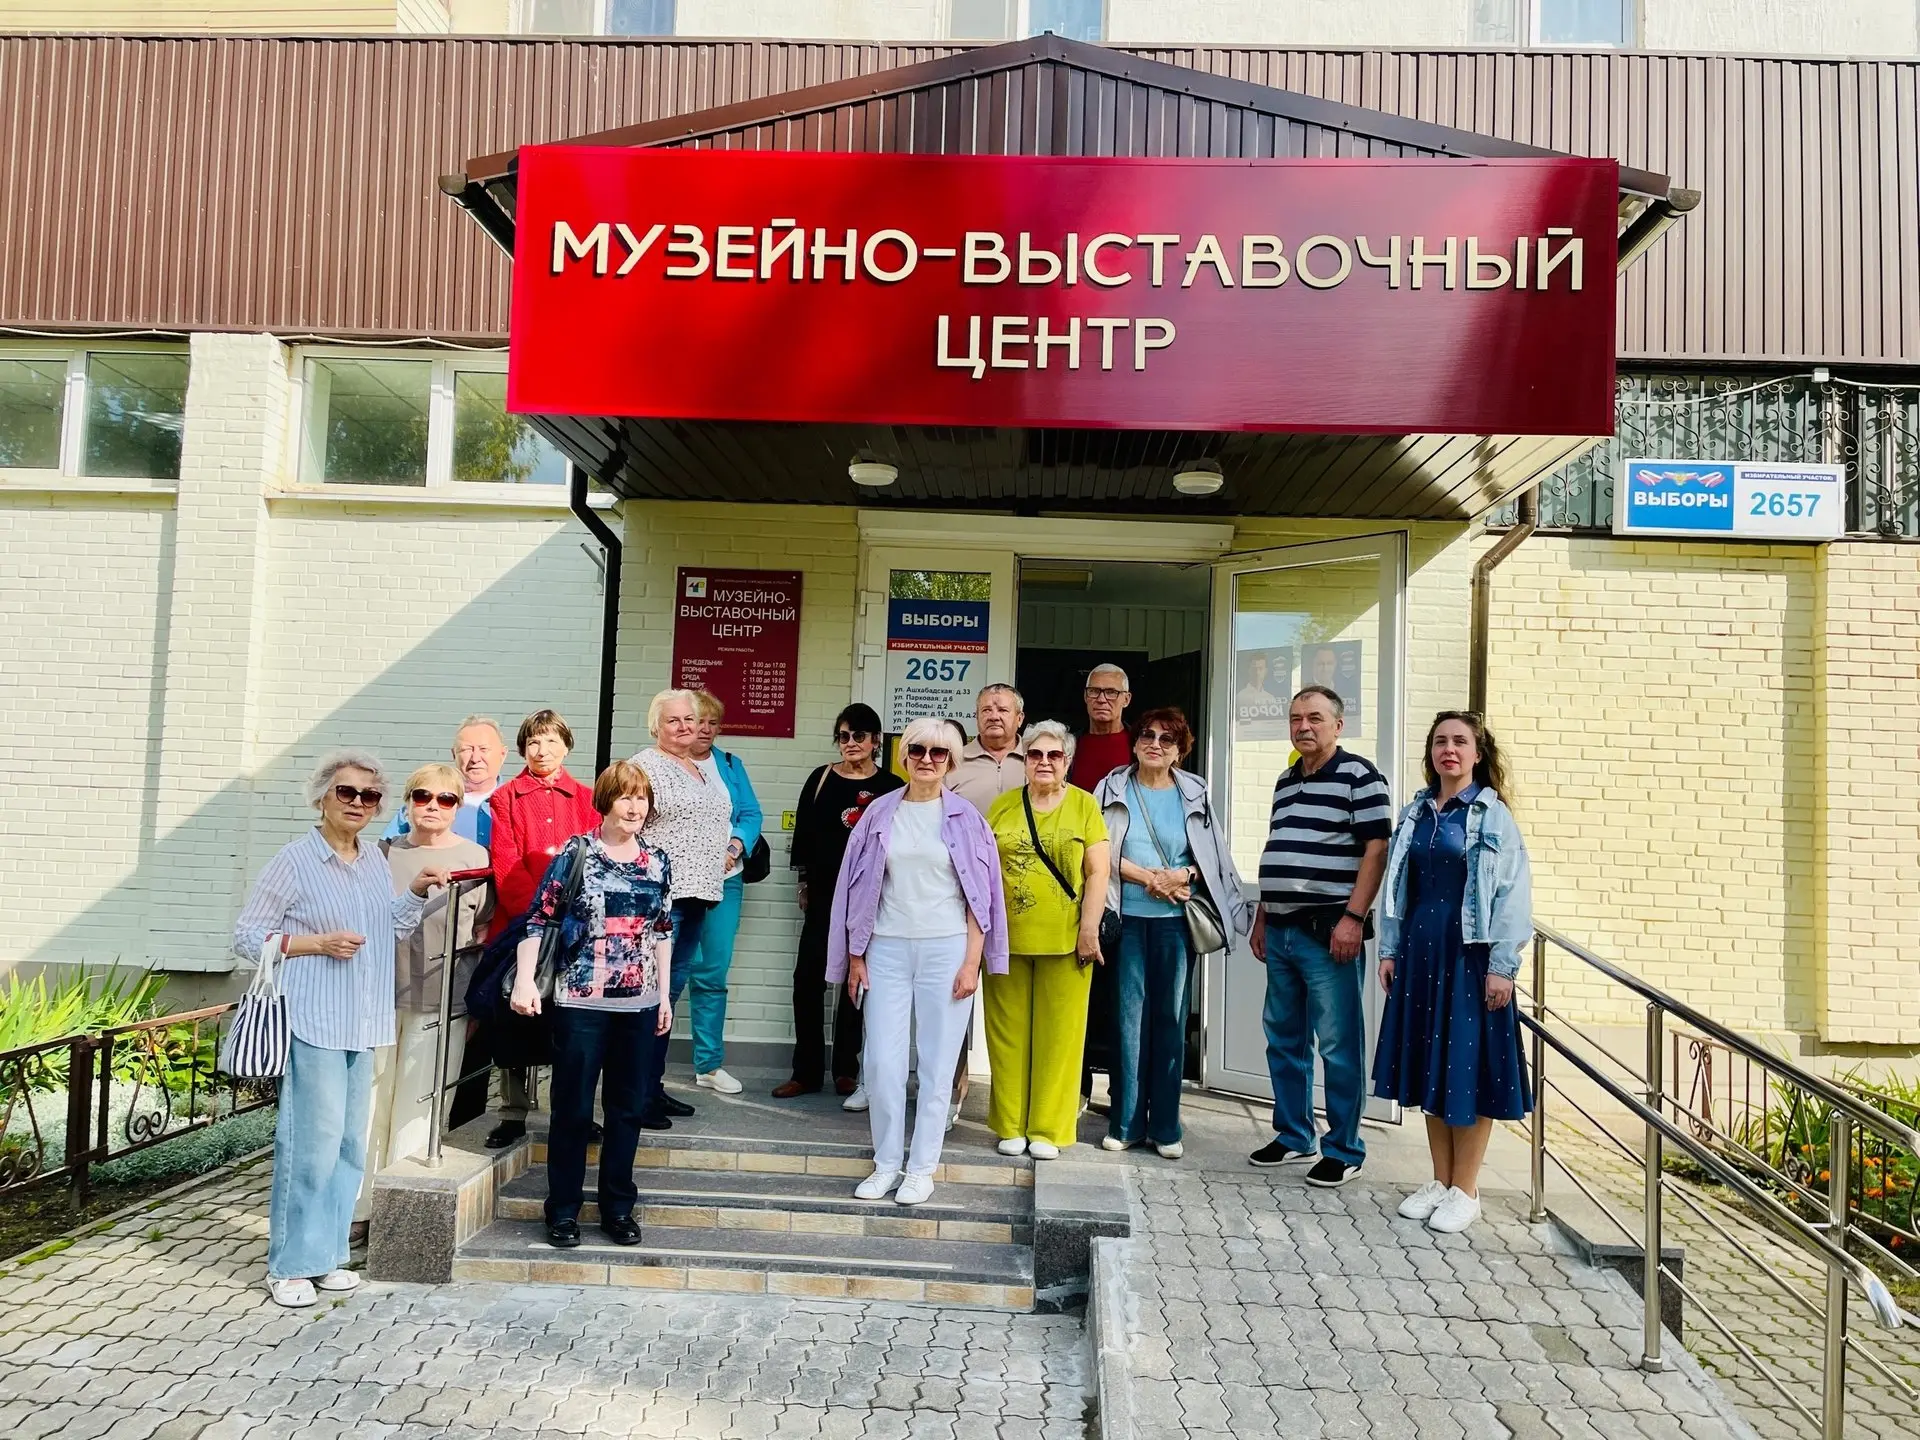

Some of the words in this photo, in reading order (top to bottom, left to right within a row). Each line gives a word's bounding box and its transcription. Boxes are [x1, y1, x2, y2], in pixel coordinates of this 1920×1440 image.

[551, 218, 1585, 292] МУЗЕЙНО-ВЫСТАВОЧНЫЙ
[936, 313, 1178, 380] ЦЕНТР
[1634, 491, 1728, 508] ВЫБОРЫ
[1750, 492, 1821, 517] 2657
[713, 590, 791, 603] МУЗЕЙНО-
[680, 605, 795, 620] ВЫСТАВОЧНЫЙ
[902, 613, 978, 627] ВЫБОРЫ
[712, 624, 762, 638] ЦЕНТР
[906, 658, 971, 681] 2657
